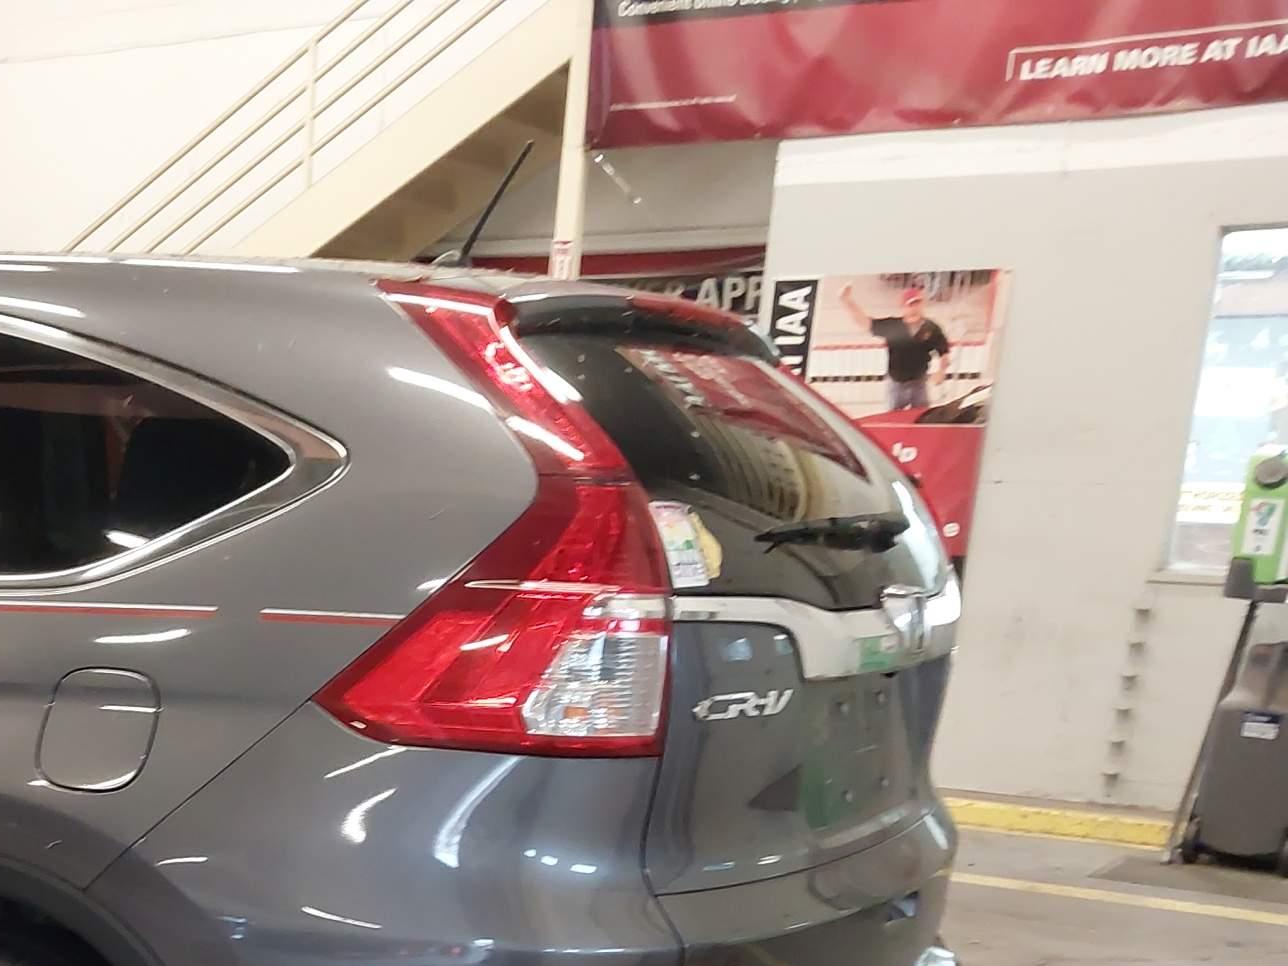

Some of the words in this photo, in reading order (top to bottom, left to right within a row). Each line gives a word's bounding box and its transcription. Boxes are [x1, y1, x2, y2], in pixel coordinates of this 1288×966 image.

[1019, 51, 1109, 80] LEARN
[1113, 42, 1200, 71] MORE
[1200, 37, 1244, 63] AT
[774, 285, 813, 346] IAA
